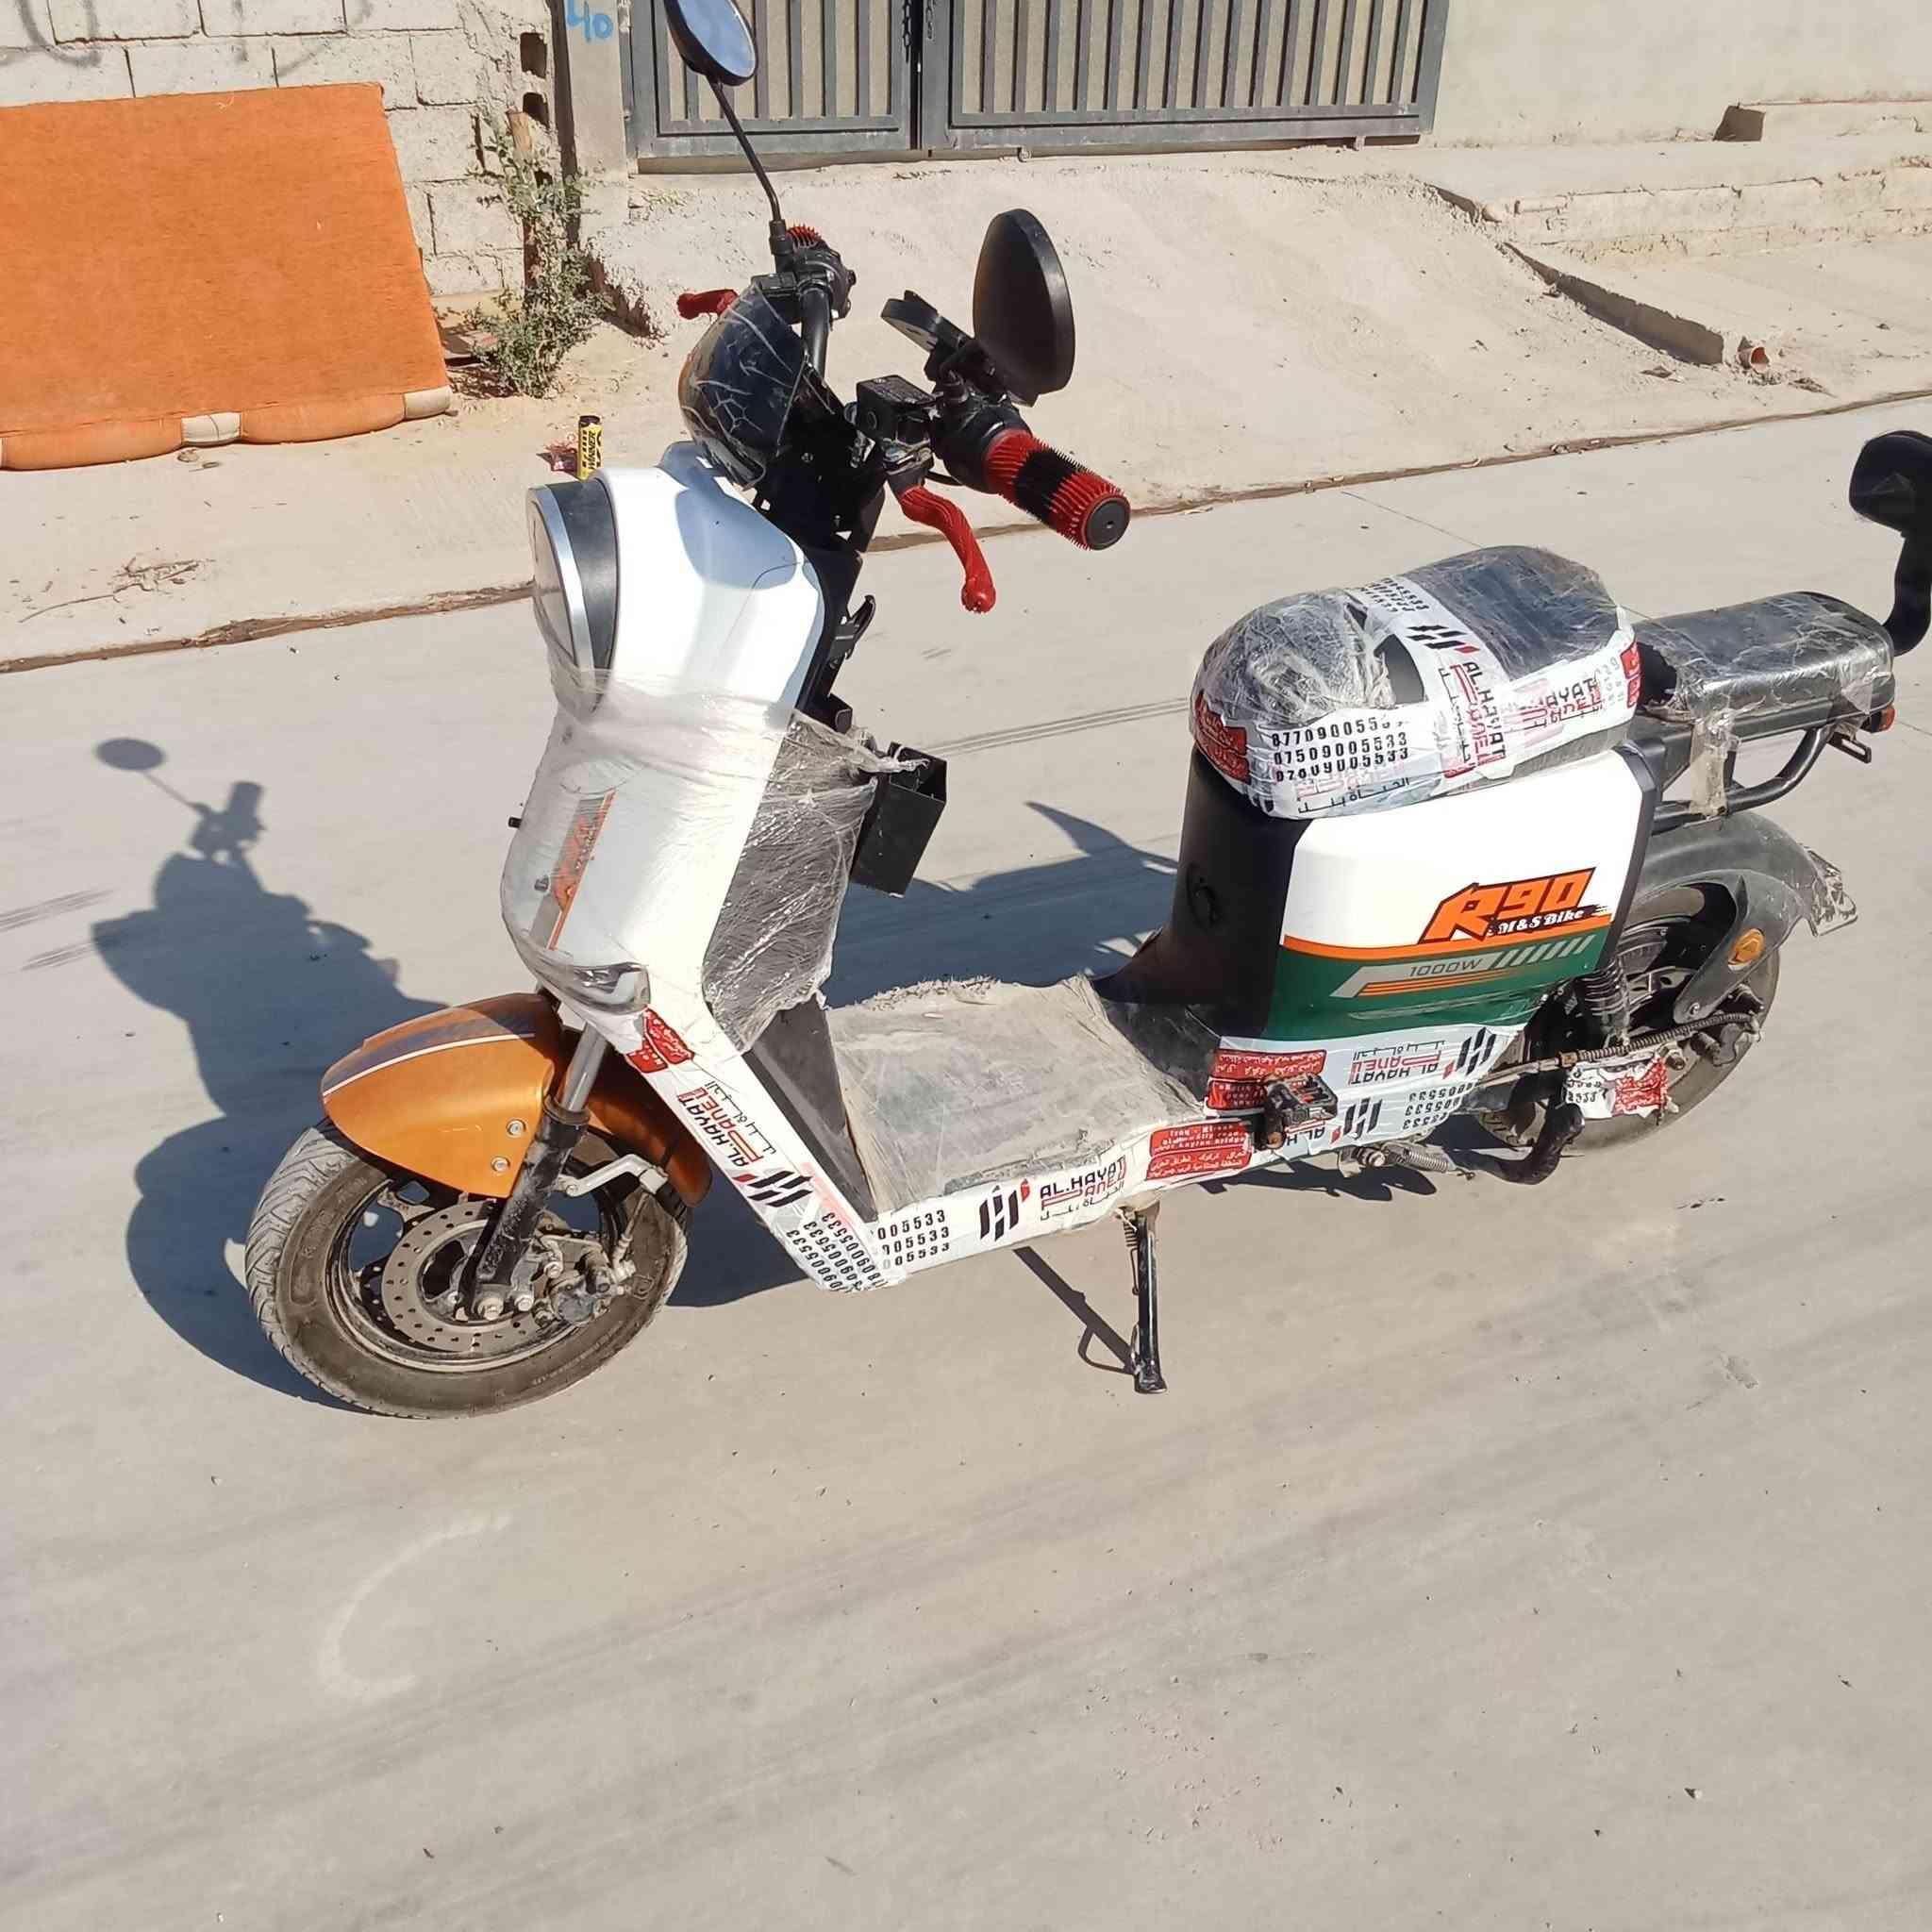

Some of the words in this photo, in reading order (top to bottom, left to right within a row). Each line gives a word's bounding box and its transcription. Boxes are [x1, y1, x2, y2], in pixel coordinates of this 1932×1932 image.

[1418, 867, 1596, 941] R90
[1409, 958, 1483, 977] 1000W
[678, 1097, 749, 1167] AL.HAYAT
[694, 1087, 764, 1162] PANEL
[1041, 1155, 1125, 1199] AL.HAYAT
[877, 1209, 945, 1240] 005533
